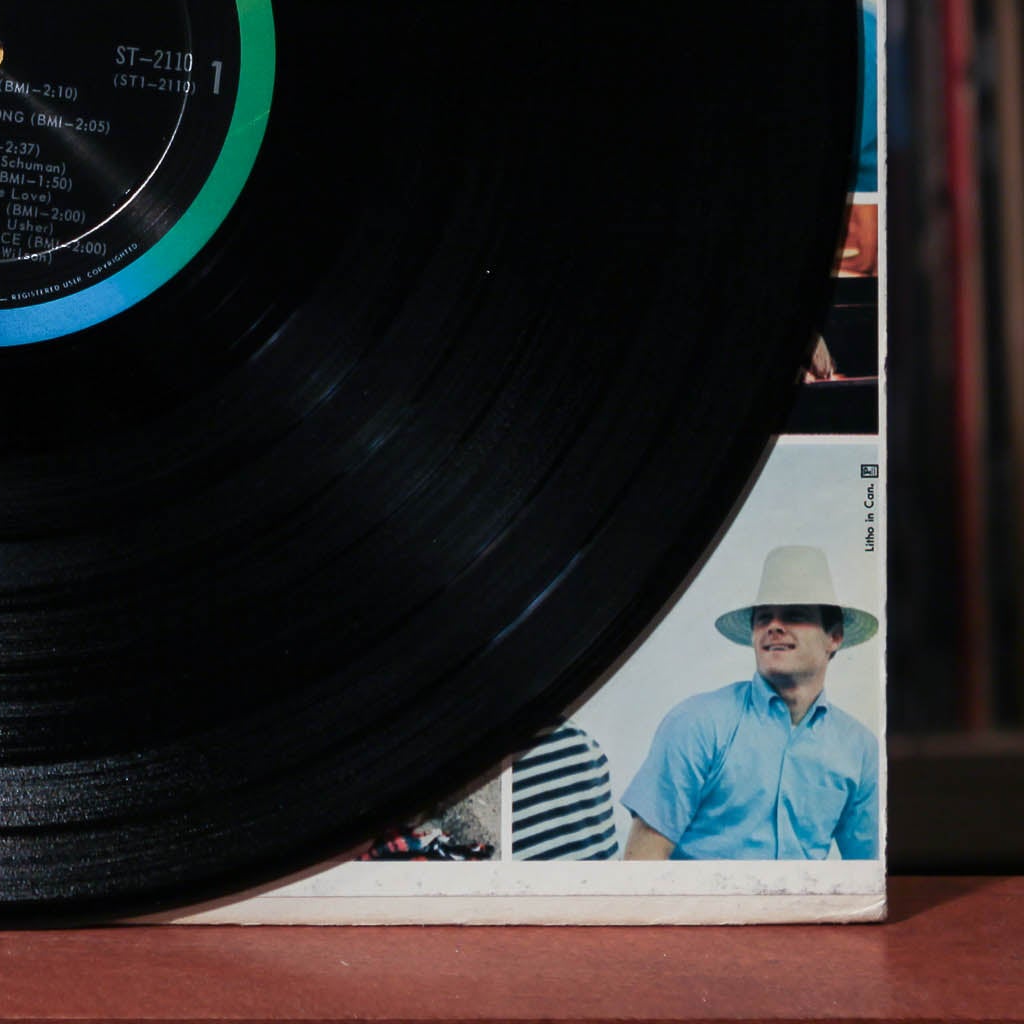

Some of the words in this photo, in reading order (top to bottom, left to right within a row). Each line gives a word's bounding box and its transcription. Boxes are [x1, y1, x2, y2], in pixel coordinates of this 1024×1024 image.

[211, 60, 223, 95] 1
[1, 155, 66, 176] Schuman)
[11, 186, 52, 203] Love)
[7, 219, 54, 236] Usher)
[11, 284, 61, 300] REGISTERED
[86, 242, 139, 278] COPYRIGHTED
[863, 483, 875, 508] Can.
[864, 512, 875, 522] in
[864, 526, 875, 552] Litho
